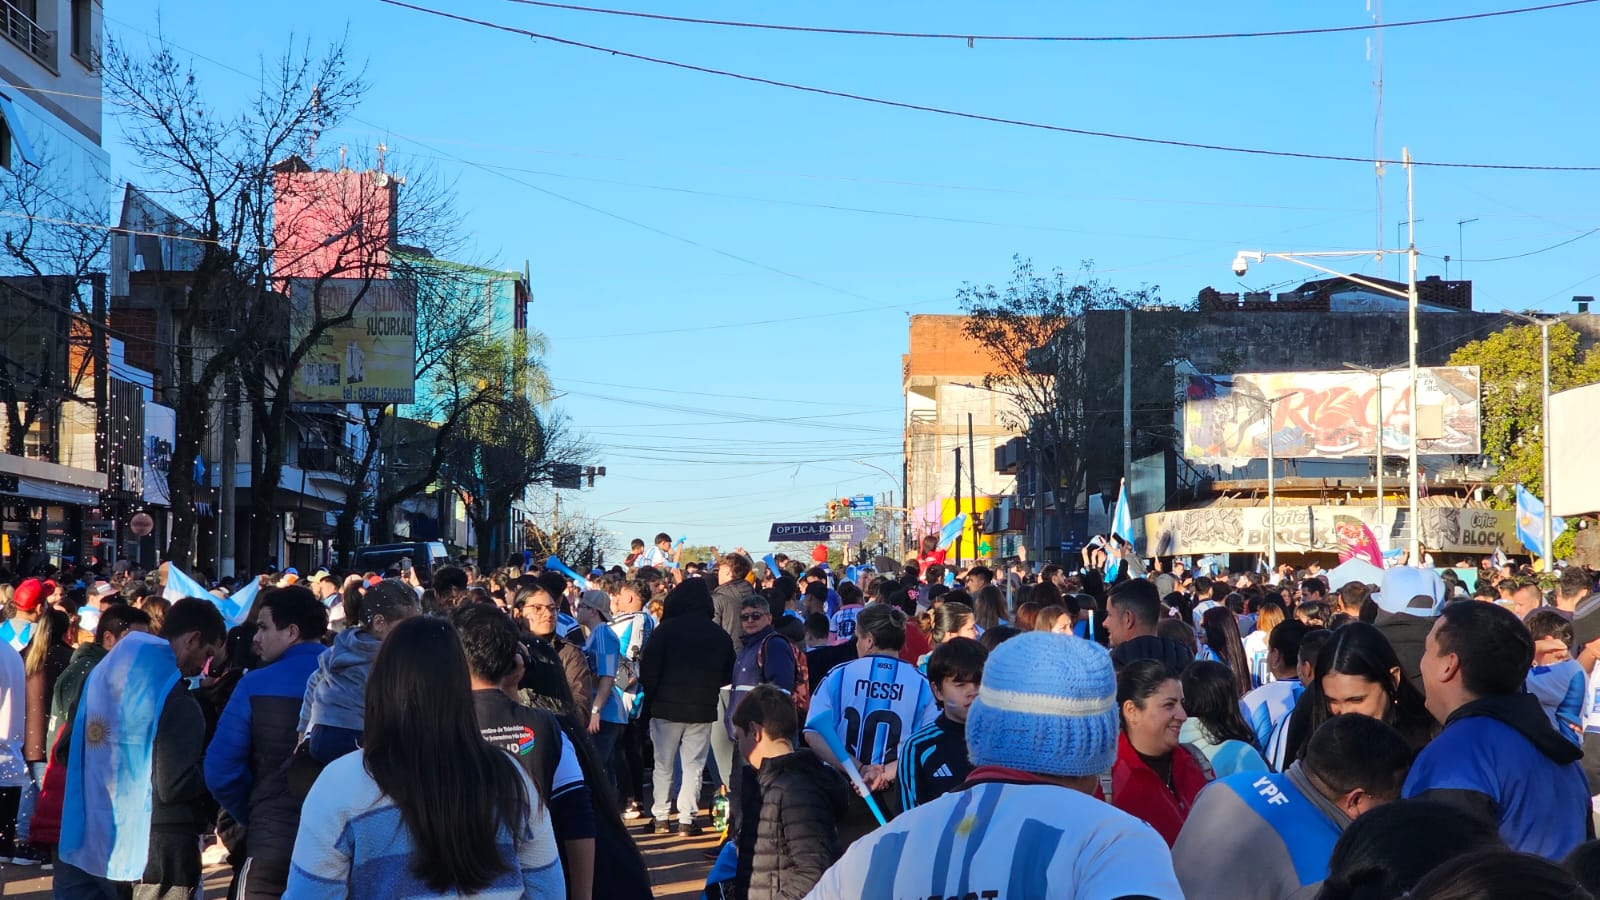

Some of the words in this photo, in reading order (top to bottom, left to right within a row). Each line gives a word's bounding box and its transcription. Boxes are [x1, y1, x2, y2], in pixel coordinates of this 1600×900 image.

[367, 317, 412, 336] SUCURSAL
[776, 525, 815, 534] OPTICA
[819, 524, 854, 533] ROLLEI
[1472, 512, 1497, 528] Cofler
[1463, 529, 1505, 546] BLOCK
[854, 679, 904, 701] MESSI
[844, 707, 902, 766] 10
[1252, 775, 1290, 806] YPF
